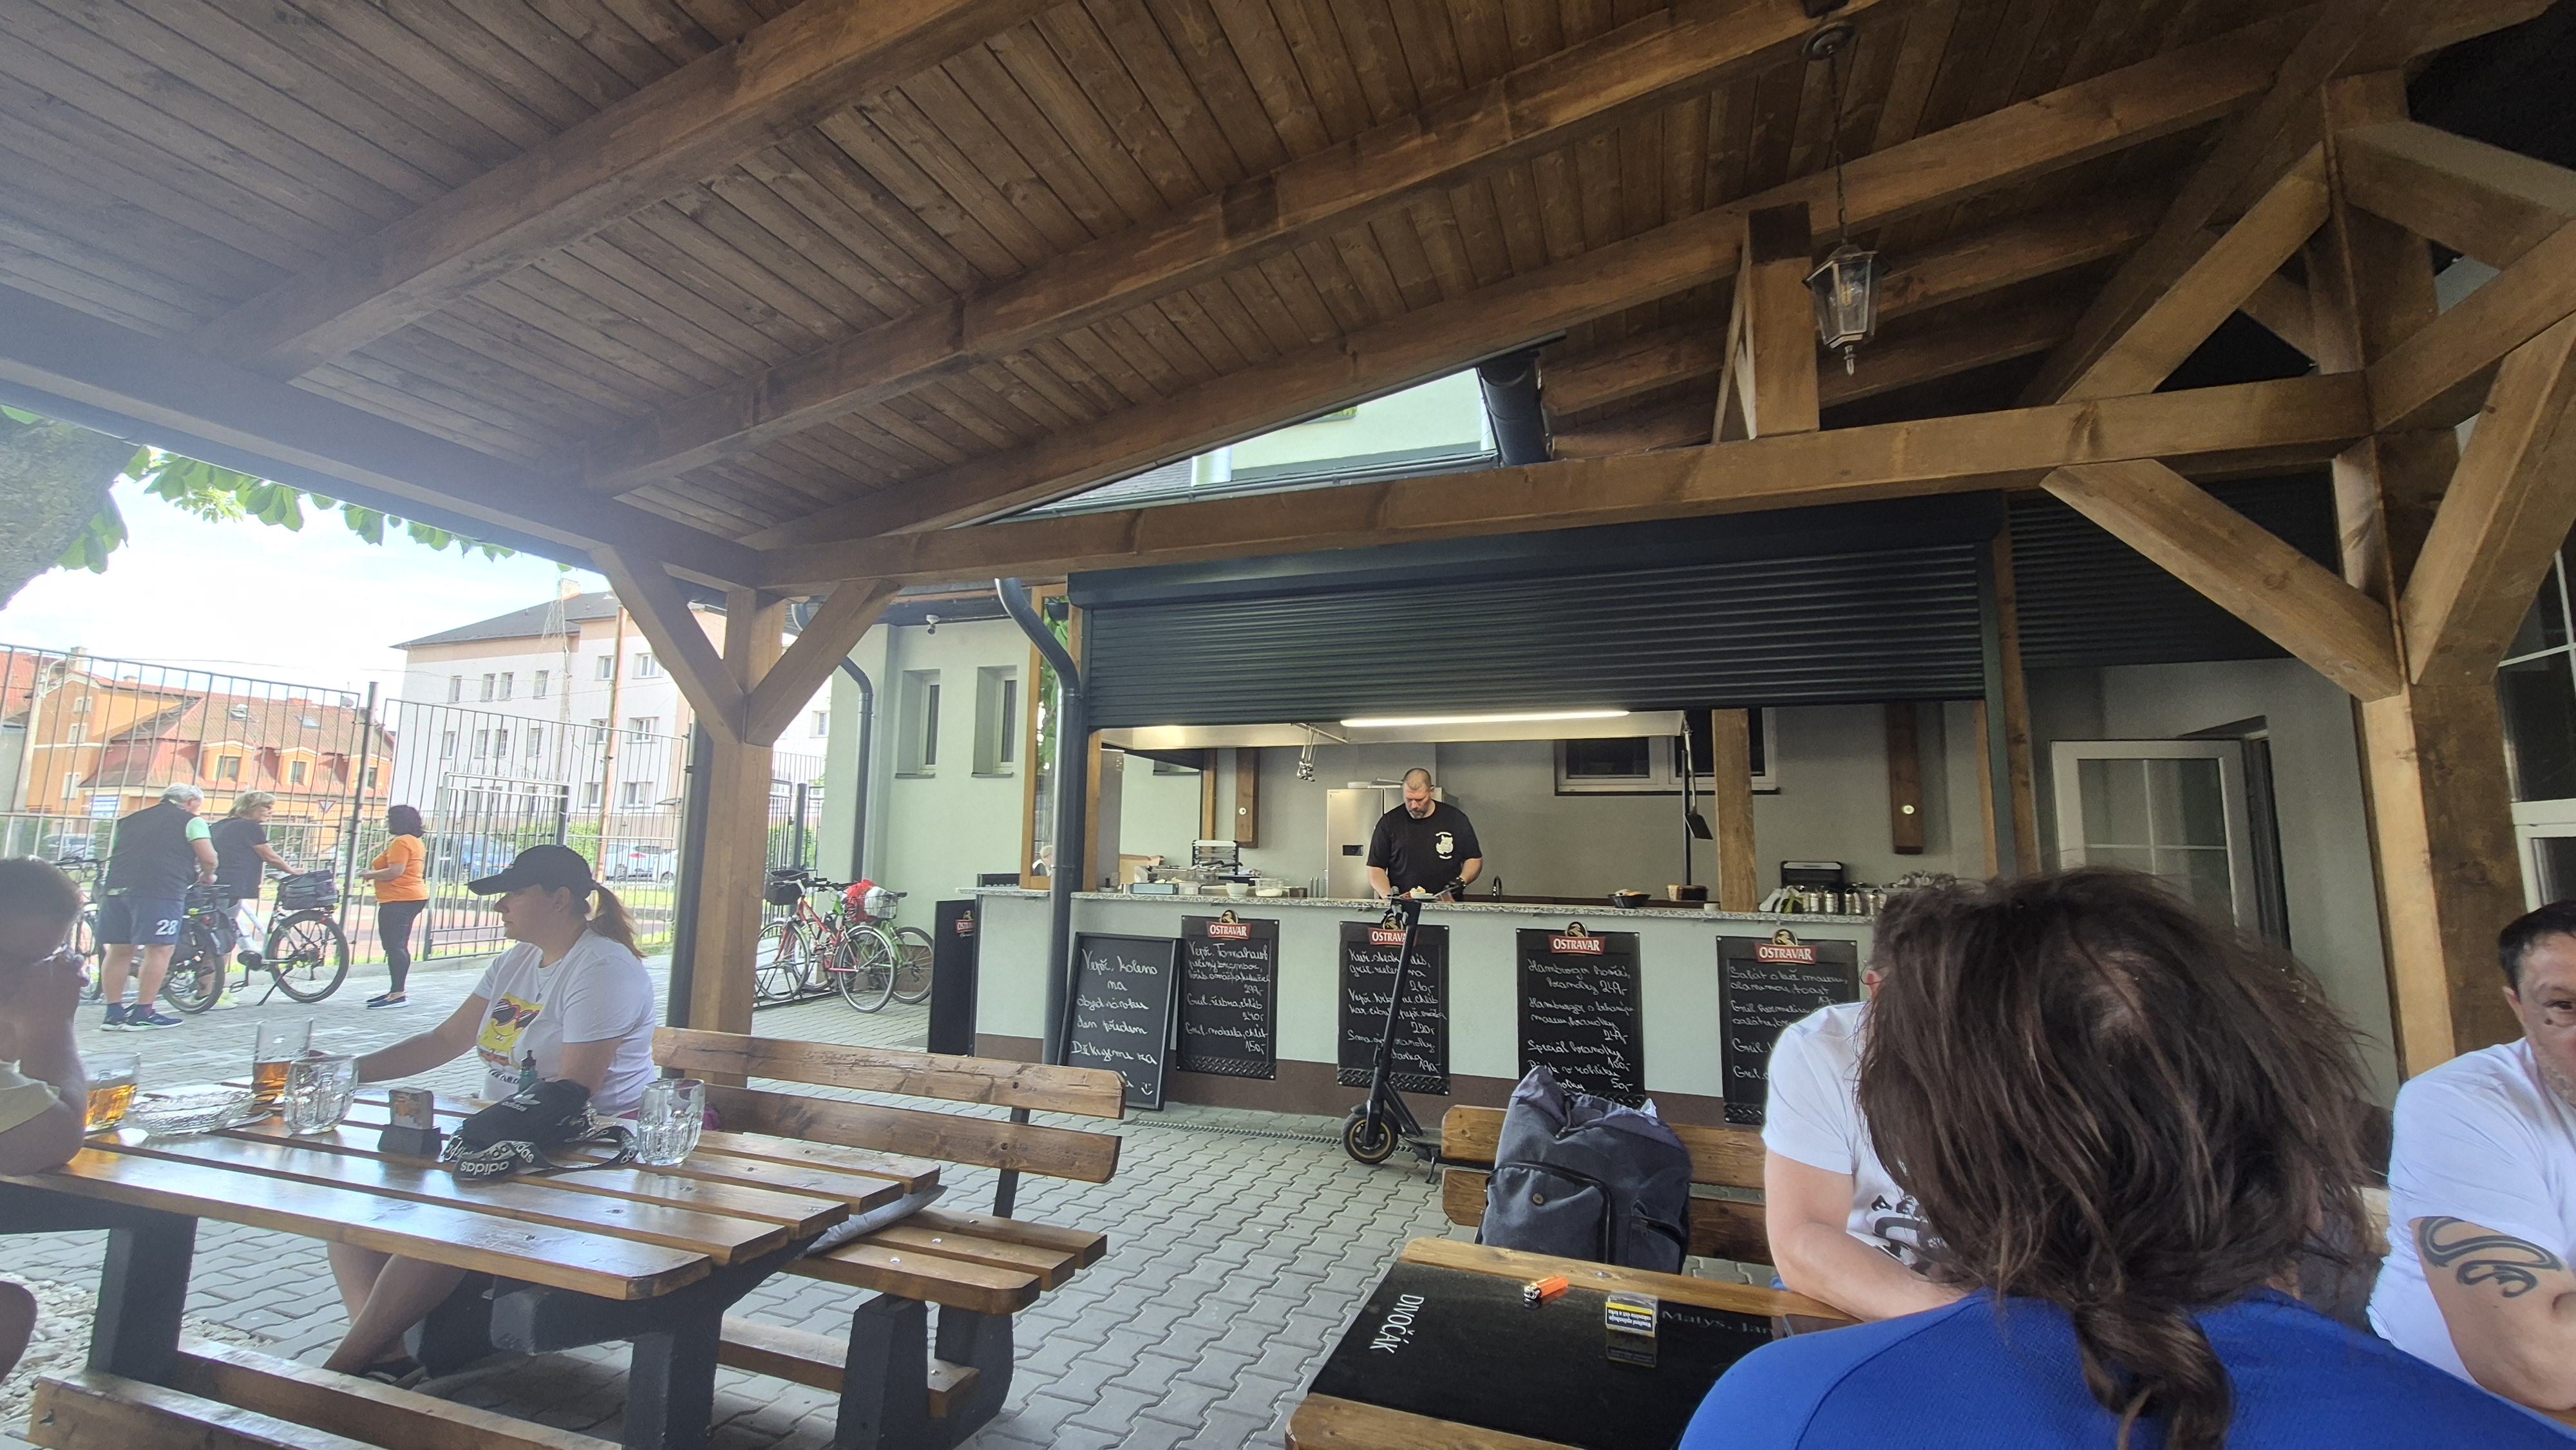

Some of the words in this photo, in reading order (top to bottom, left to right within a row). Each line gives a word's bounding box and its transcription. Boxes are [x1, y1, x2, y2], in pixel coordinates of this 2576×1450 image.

[155, 919, 179, 935] 28
[1209, 925, 1247, 936] OSTRAVAR
[1553, 939, 1601, 952] OSTRAVAR
[1759, 946, 1814, 961] OSTRAVAR
[1117, 956, 1158, 975] koleno
[1108, 980, 1128, 991] na
[1600, 980, 1628, 995] 249,-
[1077, 1015, 1097, 1028] den
[1103, 1019, 1148, 1034] předem
[1603, 1029, 1628, 1044] 249,-
[1245, 1040, 1266, 1055] 150,-
[1137, 1053, 1157, 1065] za
[1607, 1056, 1631, 1071] 100,-
[1611, 1078, 1633, 1093] 50,-
[460, 1160, 510, 1176] adidas
[1369, 1294, 1425, 1353] DIVOČÁK
